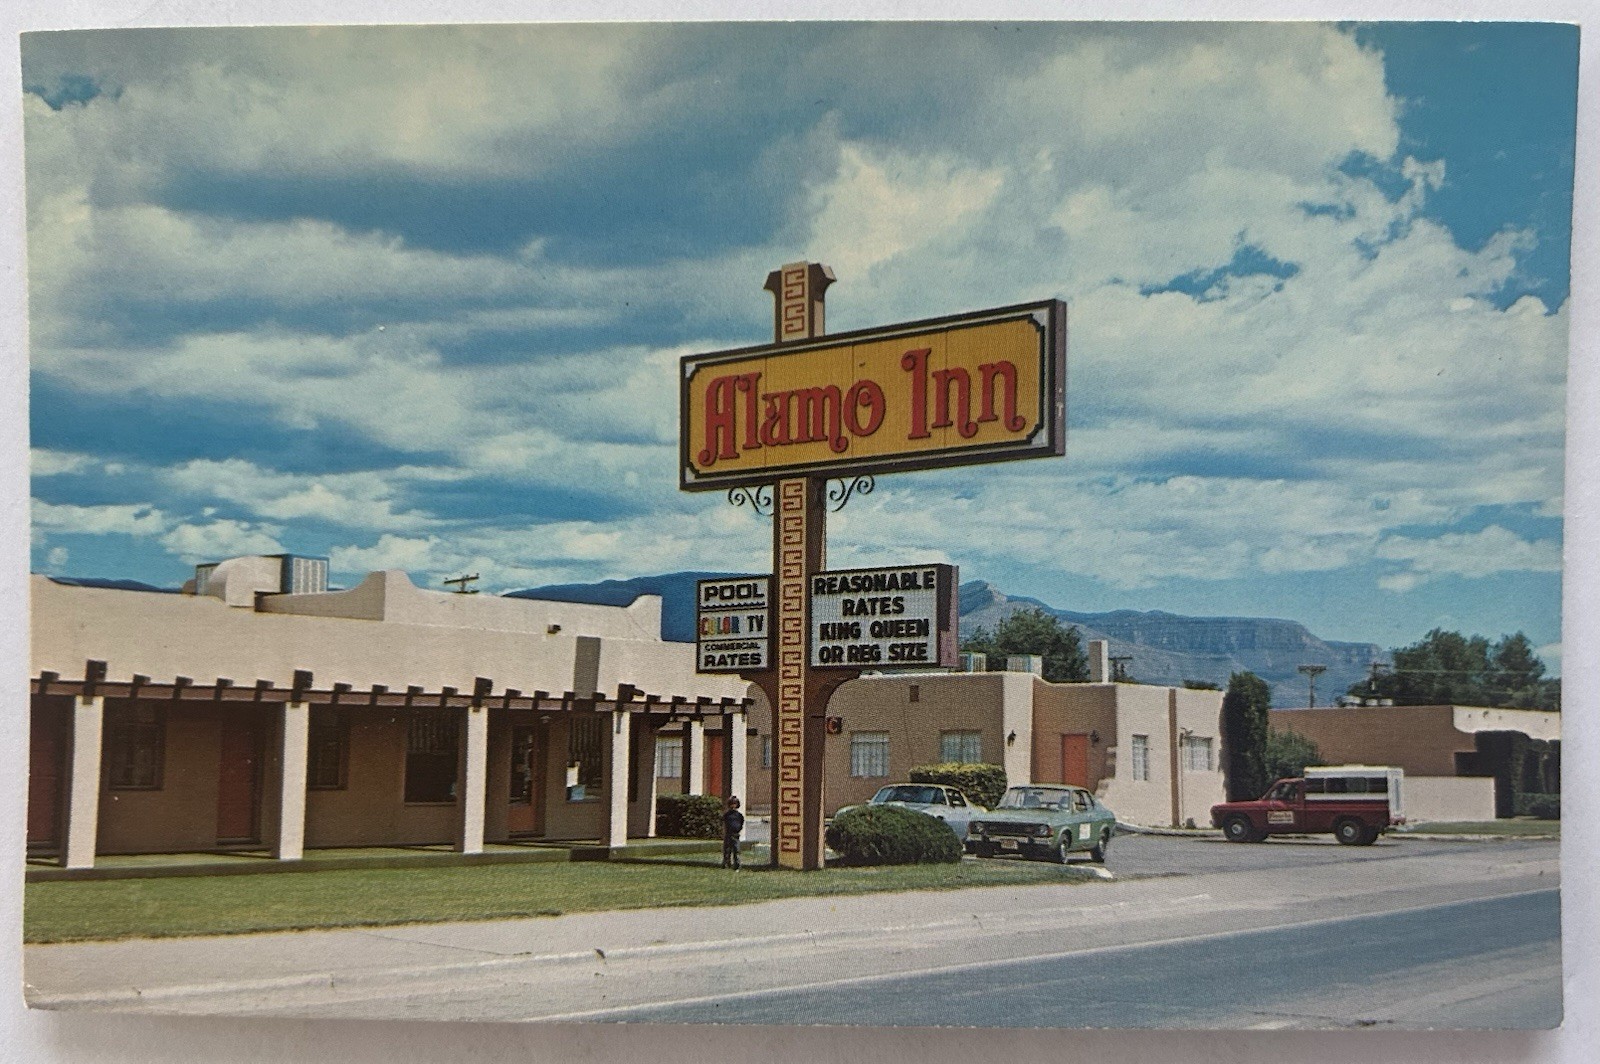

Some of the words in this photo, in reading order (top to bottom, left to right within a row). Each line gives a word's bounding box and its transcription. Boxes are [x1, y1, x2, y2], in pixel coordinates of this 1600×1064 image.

[698, 371, 886, 467] Alamo
[901, 347, 1026, 440] Inn
[704, 583, 765, 601] POOL
[814, 571, 936, 595] REASONABLE
[842, 597, 904, 616] RATES
[700, 616, 740, 635] COLOR
[747, 615, 764, 632] TV
[819, 621, 861, 640] KING
[870, 619, 929, 638] QUEEN
[705, 642, 760, 651] COMMERCIAL
[818, 646, 843, 663] OR
[847, 644, 881, 662] REG
[888, 642, 928, 661] SIZE
[704, 653, 761, 666] RATES
